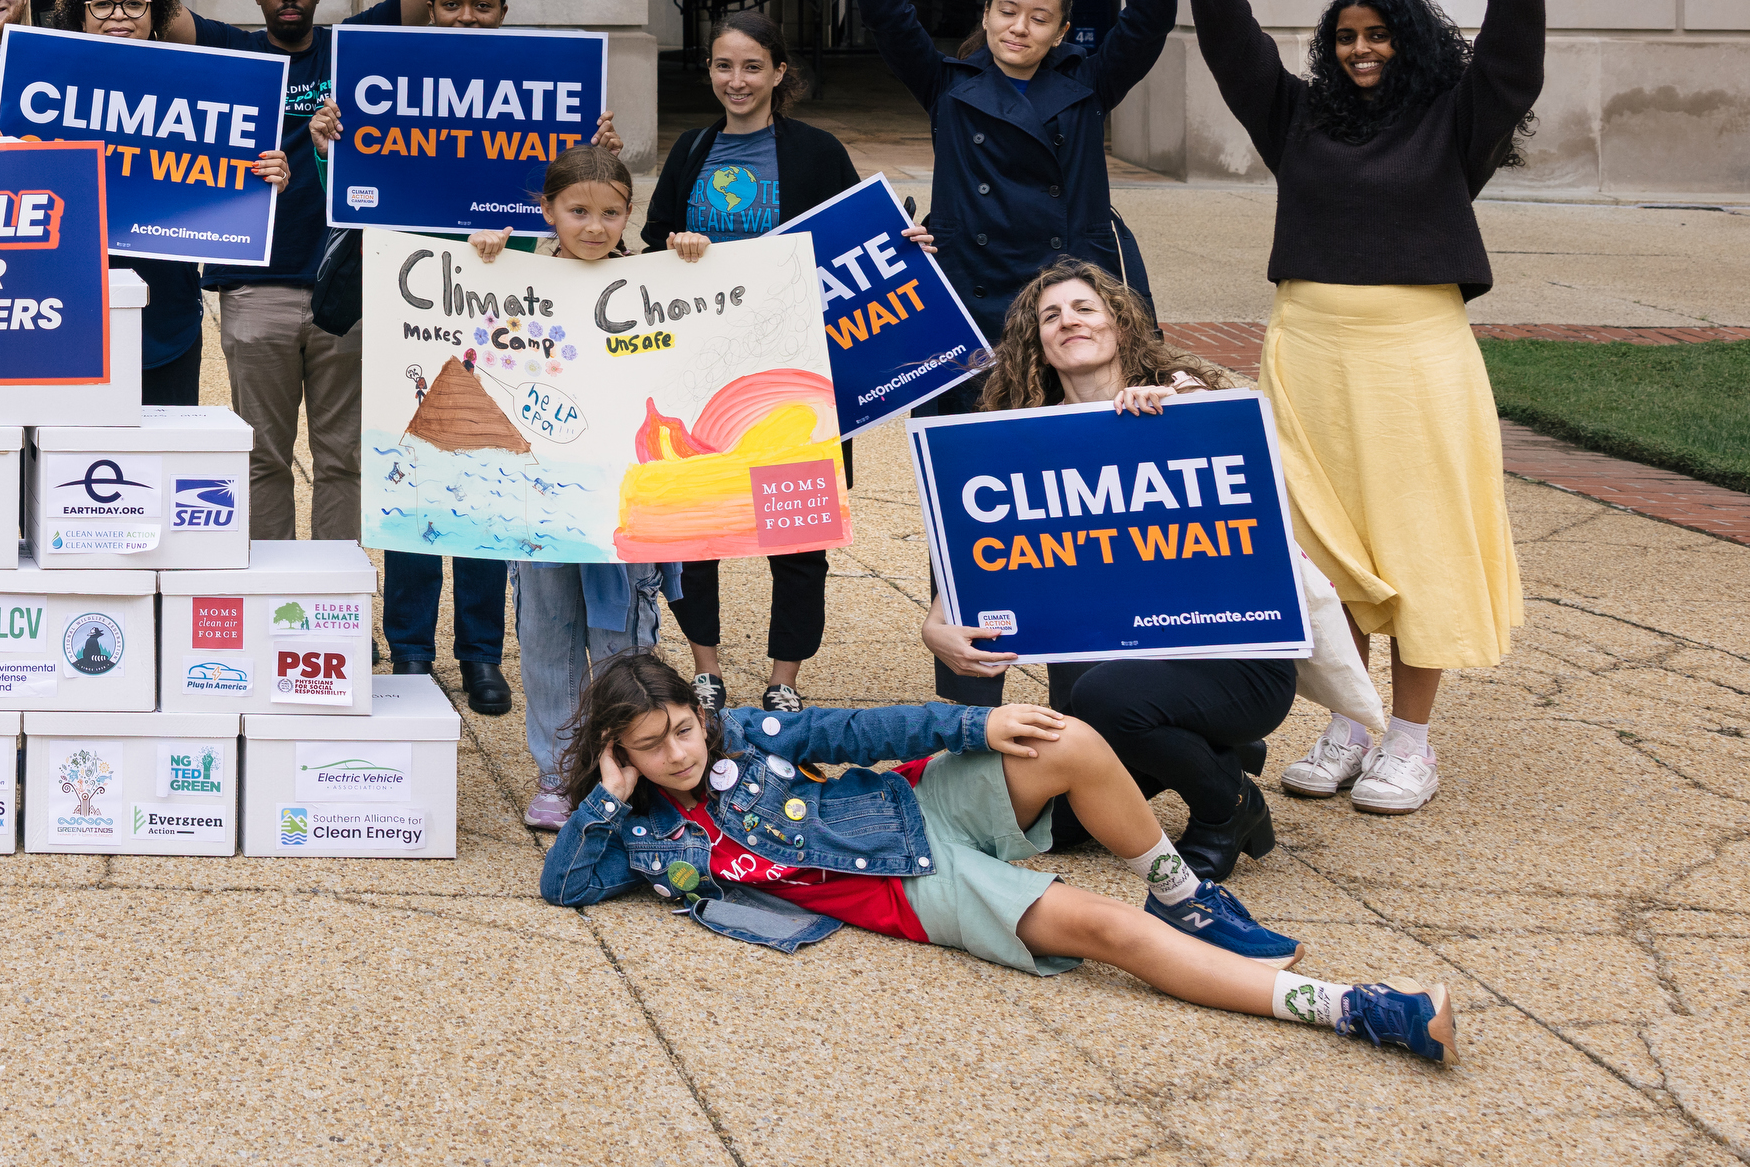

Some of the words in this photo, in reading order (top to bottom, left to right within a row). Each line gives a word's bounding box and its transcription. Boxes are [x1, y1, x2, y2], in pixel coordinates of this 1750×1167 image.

[355, 75, 582, 122] CLIMATE
[20, 82, 259, 148] CLIMATE
[354, 126, 473, 158] CAN'T
[150, 149, 253, 190] WAIT
[131, 223, 251, 243] ActOnClimate.com
[398, 249, 554, 319] Climate
[595, 279, 746, 334] Change
[825, 278, 925, 350] WAIT
[857, 343, 966, 406] ActOnClimate.com
[762, 477, 826, 495] MOMS
[962, 455, 1252, 523] CLIMATE
[63, 506, 144, 515] EARTHDAY.ORG
[764, 496, 802, 512] clean
[808, 495, 829, 508] air
[173, 510, 234, 526] SEIU
[765, 512, 832, 530] FORCE
[973, 528, 1118, 571] CAN'T
[1128, 519, 1258, 561] WAIT
[315, 604, 359, 612] ELDERS
[199, 619, 222, 627] clean
[224, 619, 237, 627] air
[314, 620, 359, 629] ACTION
[315, 613, 359, 621] CLIMATE
[1133, 610, 1281, 627] ActOnClimate.com
[278, 651, 347, 679] PSR
[187, 681, 204, 690] Plug
[215, 682, 247, 691] America
[170, 780, 221, 792] GREEN
[317, 773, 360, 782] Electric
[363, 773, 403, 783] Vehicle
[148, 814, 223, 827] Evergreen
[313, 815, 361, 823] Southern
[364, 815, 405, 823] Alliance
[408, 817, 421, 825] for
[313, 827, 362, 838] Clean
[367, 827, 422, 843] Energy
